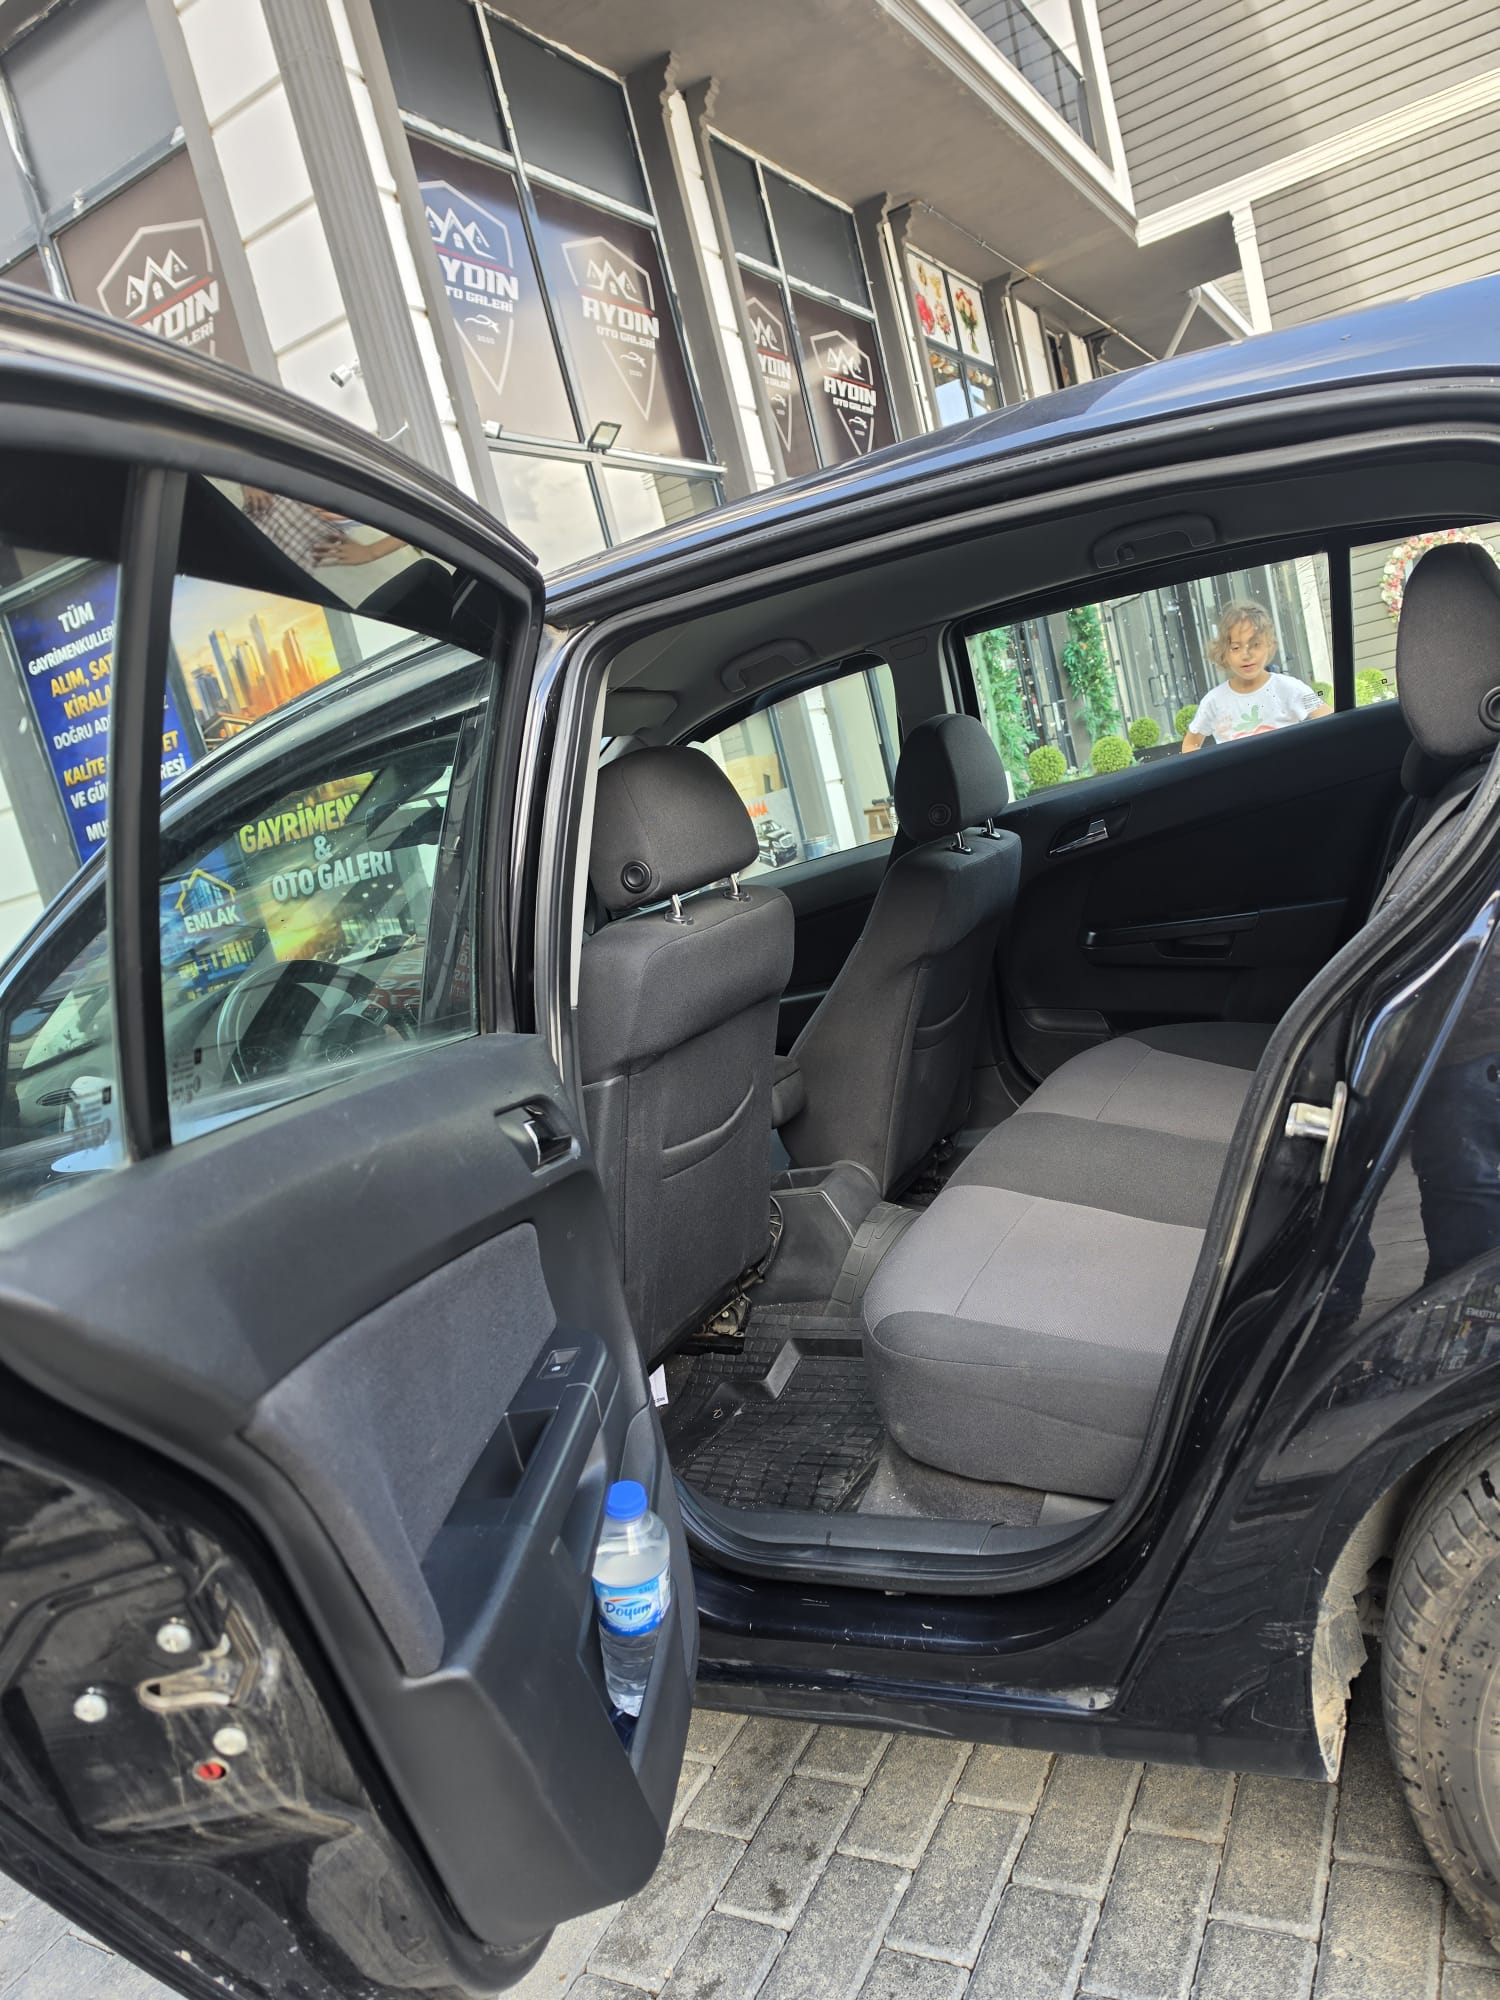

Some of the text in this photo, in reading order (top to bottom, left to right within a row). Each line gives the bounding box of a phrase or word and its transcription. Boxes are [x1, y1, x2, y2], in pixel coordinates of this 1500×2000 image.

[437, 254, 519, 301] YDIN
[141, 280, 219, 339] YDIN
[582, 295, 660, 339] AYDIN
[757, 353, 792, 380] YDIN
[823, 375, 877, 407] AYDIN
[57, 601, 95, 633] TÜM
[51, 652, 113, 697] ALIM, SAT
[53, 722, 93, 750] DOĞRU
[63, 756, 105, 787] KALİTE
[70, 780, 87, 809] VE
[313, 835, 333, 861] &
[272, 868, 315, 901] OTO
[183, 905, 240, 934] EMLAK
